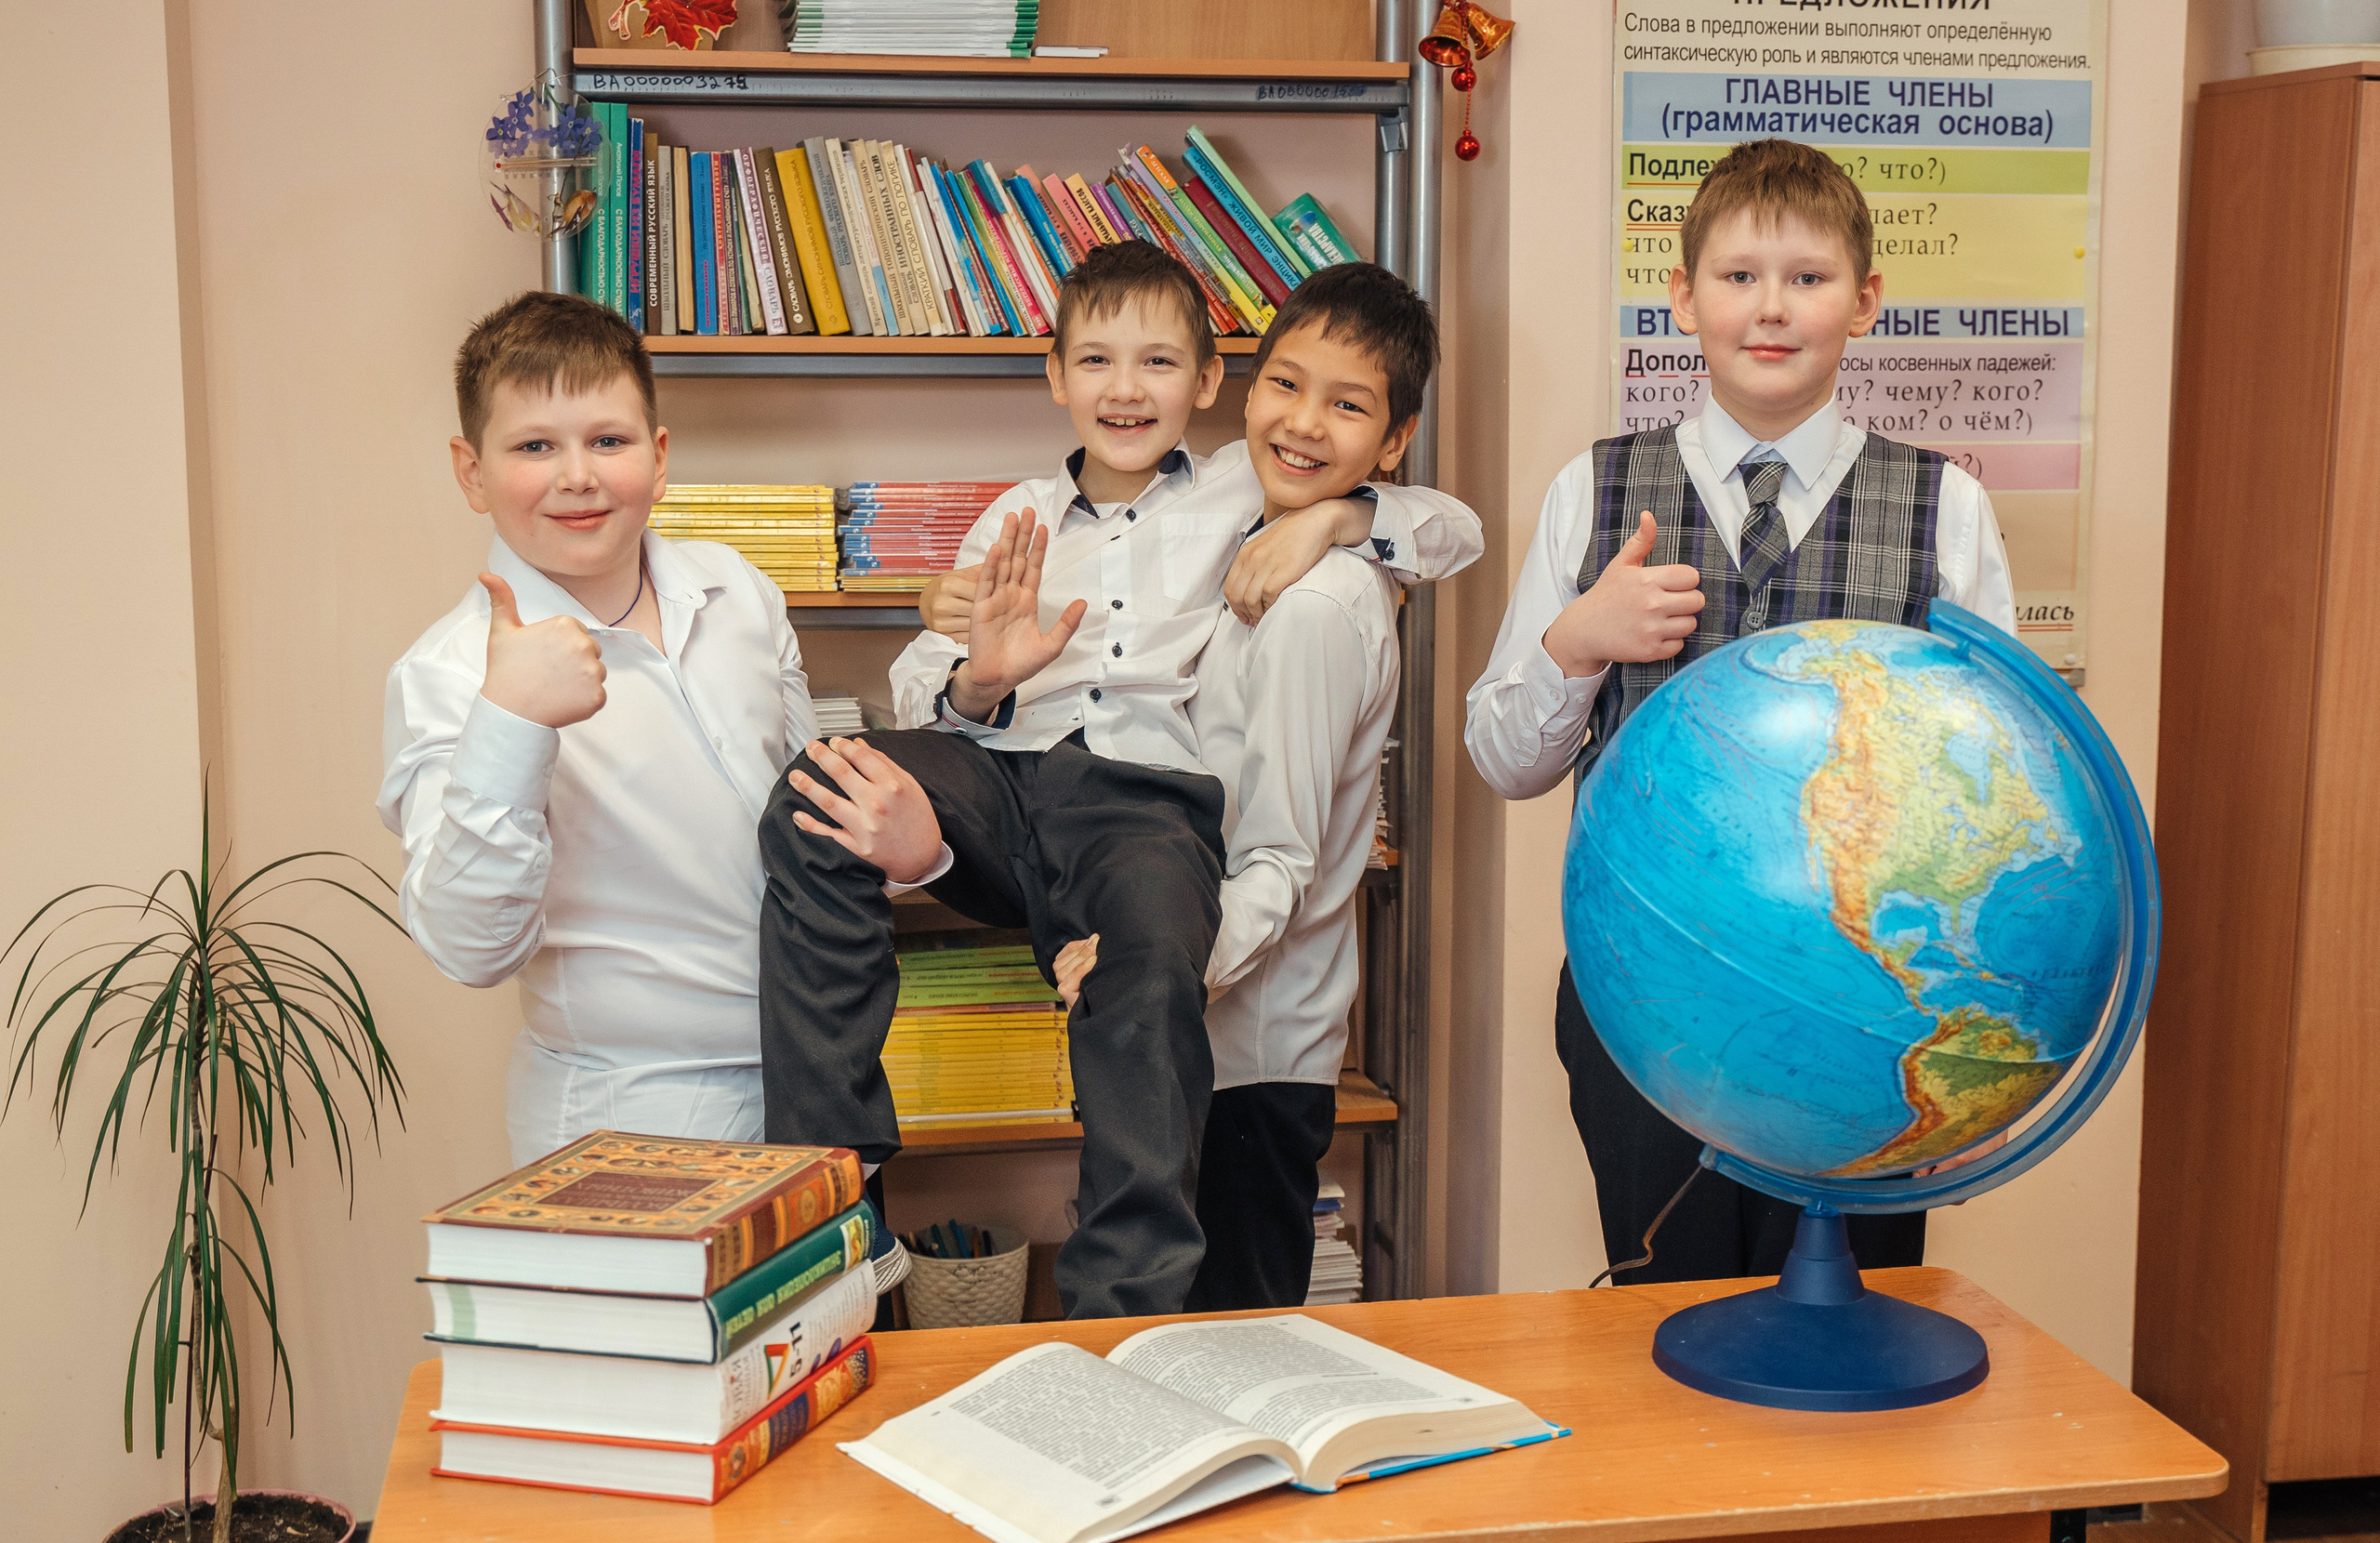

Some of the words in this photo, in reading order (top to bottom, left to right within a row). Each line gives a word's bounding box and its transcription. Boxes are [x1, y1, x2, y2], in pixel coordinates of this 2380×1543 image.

[1624, 12, 1680, 33] Слова
[1686, 19, 1696, 33] в
[1701, 19, 1819, 38] предложении
[1825, 21, 1922, 38] выполняют
[1926, 21, 2052, 45] определённую
[1624, 45, 1757, 67] синтаксическую
[1763, 47, 1801, 67] роль
[1806, 50, 1816, 63] и
[1821, 49, 1898, 65] являются
[1903, 52, 1973, 66] членами
[1979, 53, 2092, 71] предложения.
[1726, 78, 1870, 107] ГЛАВНЫЕ
[1889, 81, 1992, 108] ЧЛЕНЫ
[1661, 102, 1920, 138] (грамматическая
[1939, 110, 2053, 144] основа)
[631, 150, 641, 204] БУМАГИ
[763, 167, 774, 192] ЯЗЫКА
[789, 159, 801, 185] ЯЗЫКА
[856, 159, 873, 194] СЛОВАРЬ
[869, 152, 885, 182] СЛОВ
[885, 159, 904, 199] ЛОГИКЕ
[1149, 159, 1170, 184] ДЕТСКАЯ
[1629, 152, 1712, 179] Подле
[1842, 156, 1868, 178] о?
[1879, 157, 1946, 185] что?)
[631, 207, 640, 226] ИЗ
[646, 188, 655, 232] РУССКИЙ
[769, 193, 783, 231] РУССКОГО
[797, 186, 812, 225] РУССКОГО
[897, 200, 908, 217] ПО
[1075, 187, 1095, 213] КЛАССОВ
[1190, 153, 1229, 200] «РОСМЭН»
[1227, 200, 1259, 235] ЖИВОЙ
[1253, 232, 1275, 256] МИР
[1627, 198, 1685, 222] Сказ
[742, 153, 770, 260] ОРФОГРАФИЧЕСКИЙ
[763, 267, 779, 314] СЛОВАРЬ
[866, 194, 894, 270] ТОПОНИМИЧЕСКИЙ
[879, 186, 907, 269] ИНОСТРАННЫХ
[902, 218, 922, 263] СЛОВАРЬ
[1091, 212, 1113, 243] АЧАЛЬНЫХ
[1307, 221, 1344, 267] ЛЕКАРСТВА
[614, 216, 622, 286] БЛАГОДАРНОСТЬЮ
[630, 230, 640, 293] ИГРУШКИ
[806, 225, 825, 275] СИНОНИМОВ
[648, 234, 657, 306] СОВРЕМЕННЫЙ
[1626, 268, 1671, 284] что
[787, 279, 800, 311] СЛОВАРЬ
[820, 275, 833, 309] СЛОВАРЬ
[887, 272, 906, 319] ШКОЛЬНЫЙ
[914, 266, 934, 310] КРАТКИЙ
[1213, 299, 1230, 321] ШКОЛЕ
[1869, 309, 1940, 336] НЫЕ
[1959, 310, 2069, 336] ЧЛЕНЫ
[1626, 349, 1707, 376] Допол
[1839, 357, 1872, 372] осы
[1879, 357, 1971, 371] косвенных
[1977, 354, 2056, 375] падежей:
[1626, 380, 1699, 402] кого?
[1885, 379, 1962, 408] чему?
[1973, 379, 2043, 401] кого?
[1626, 410, 1685, 434] что?
[1868, 409, 1928, 430] ком?
[1939, 415, 1952, 430] о
[1964, 409, 2032, 436] чём?)
[2016, 605, 2074, 621] лась
